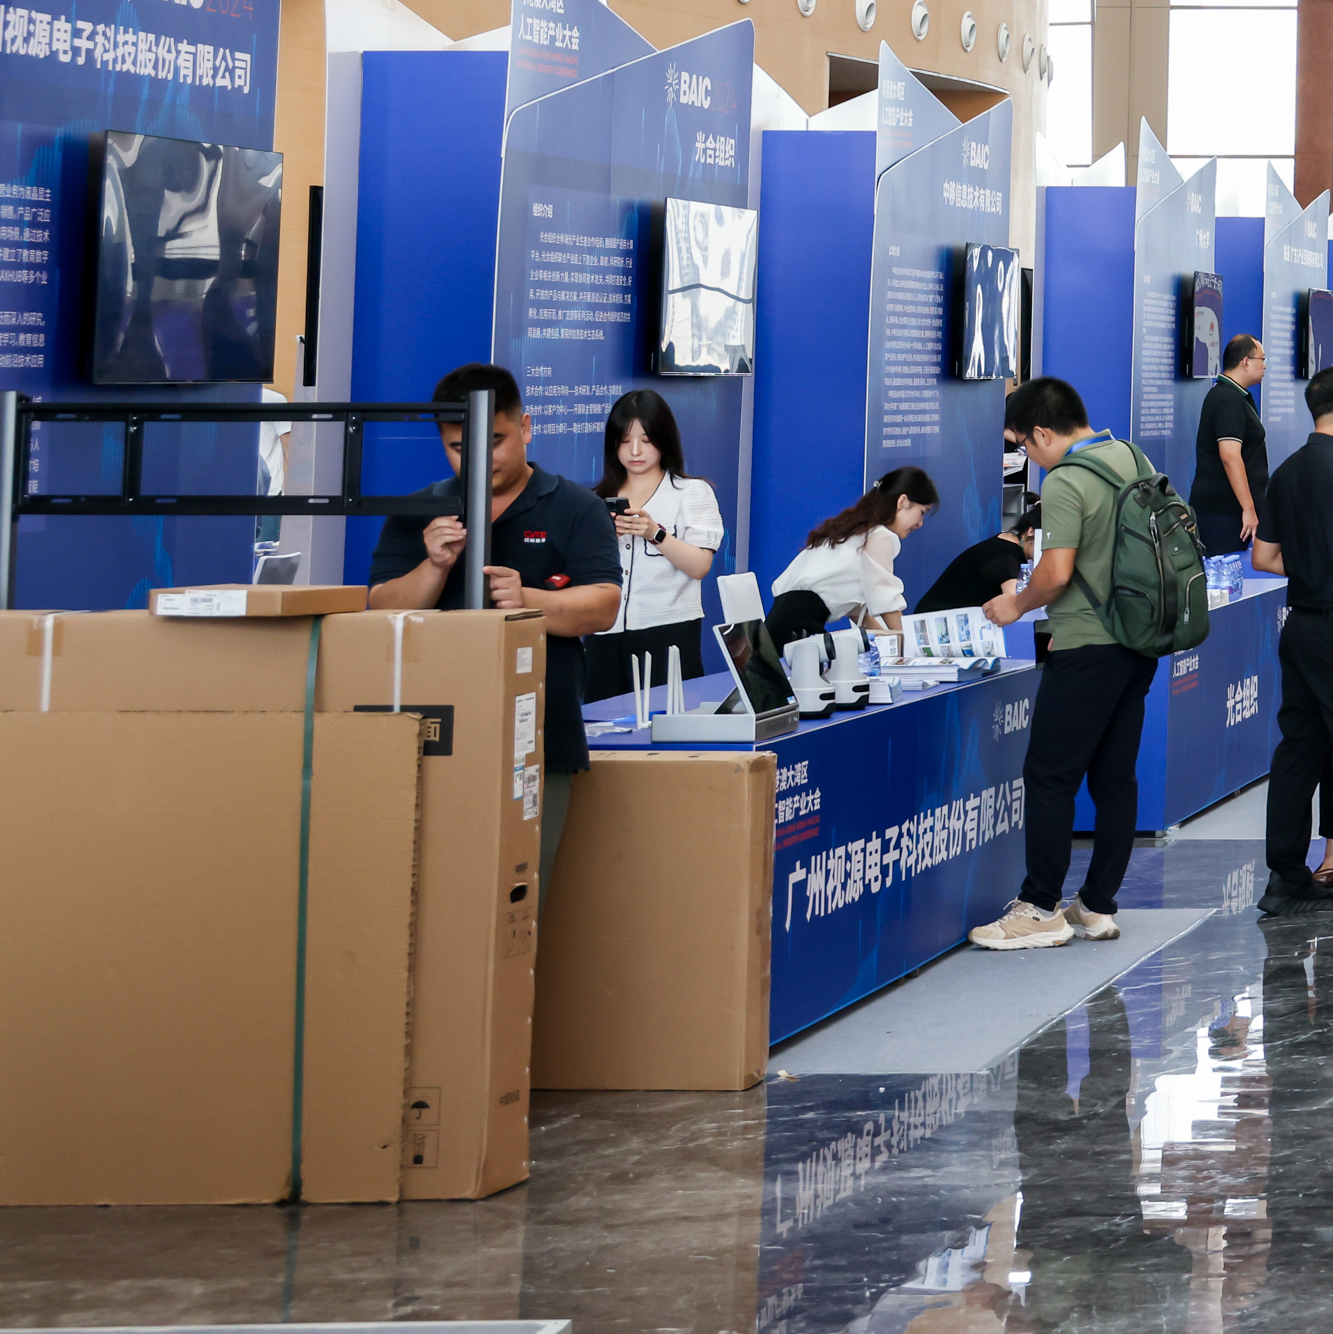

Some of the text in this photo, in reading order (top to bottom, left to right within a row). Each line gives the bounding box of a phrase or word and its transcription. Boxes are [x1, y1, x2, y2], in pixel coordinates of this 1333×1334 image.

[518, 13, 580, 51] 人工智能产业大会
[679, 71, 712, 110] BAIC
[695, 131, 736, 168] 光合组织
[970, 141, 990, 171] BAIC
[943, 179, 1003, 216] 中移信息技术有限公司
[1190, 192, 1203, 215] BAIC
[1003, 697, 1031, 735] BAIC
[1226, 674, 1259, 728] 光合组织
[784, 776, 1026, 933] 广州视源电子科技股份有限公司
